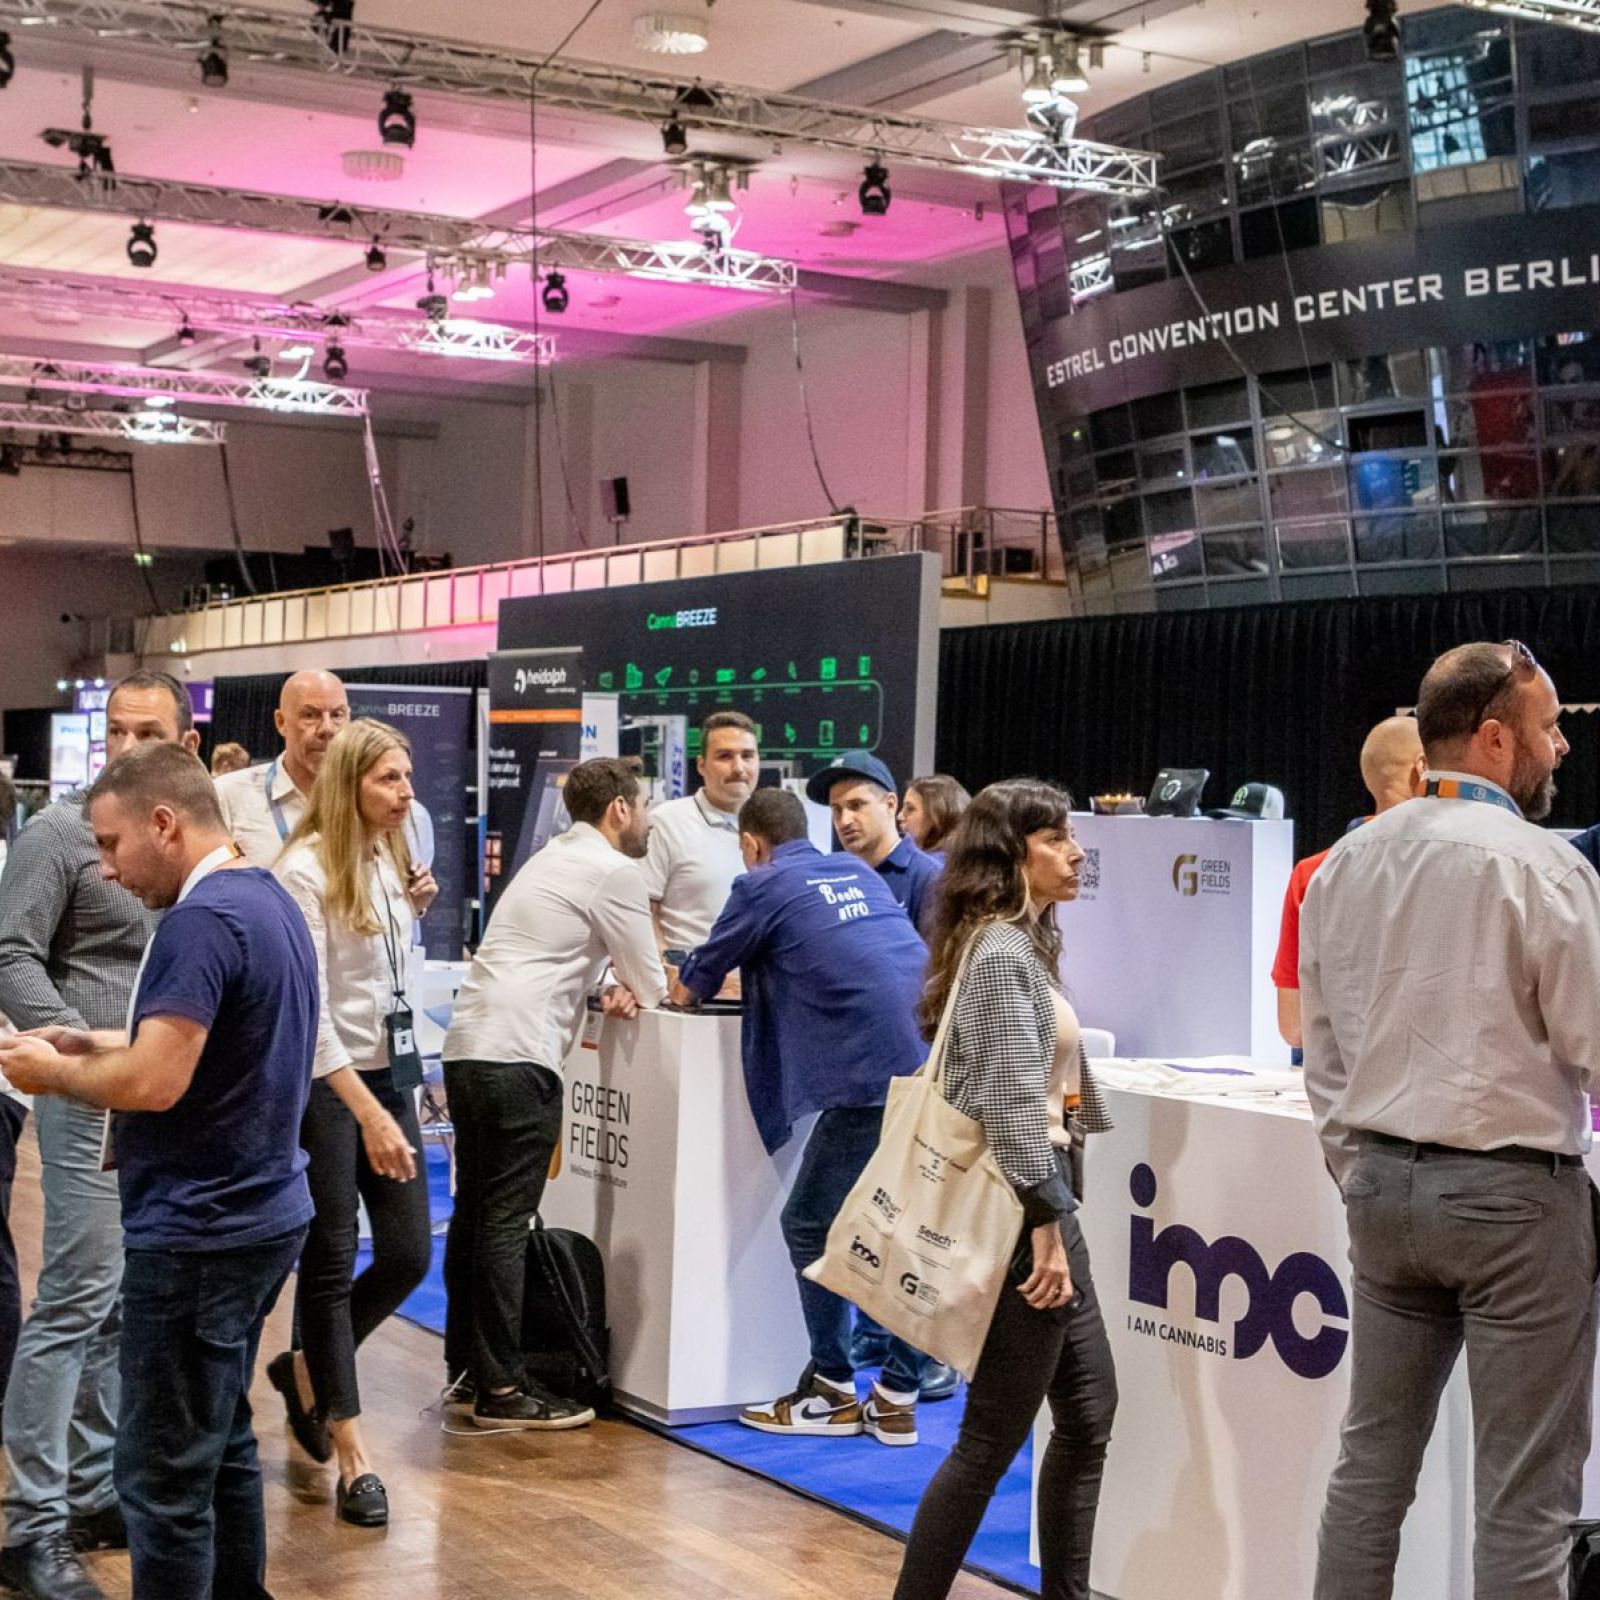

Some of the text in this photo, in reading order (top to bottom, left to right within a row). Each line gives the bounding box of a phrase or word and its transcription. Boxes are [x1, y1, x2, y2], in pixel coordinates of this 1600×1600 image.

[1046, 253, 1600, 388] ESTREL CONVENTION CENTER BERLI
[1201, 859, 1231, 873] GREEN
[1201, 874, 1231, 889] FIELDS
[818, 883, 866, 905] Booth
[571, 1080, 631, 1126] GREEN
[569, 1121, 629, 1169] FIELDS
[1129, 1162, 1350, 1380] imc
[1127, 1314, 1228, 1357] I AM CANNABIS
